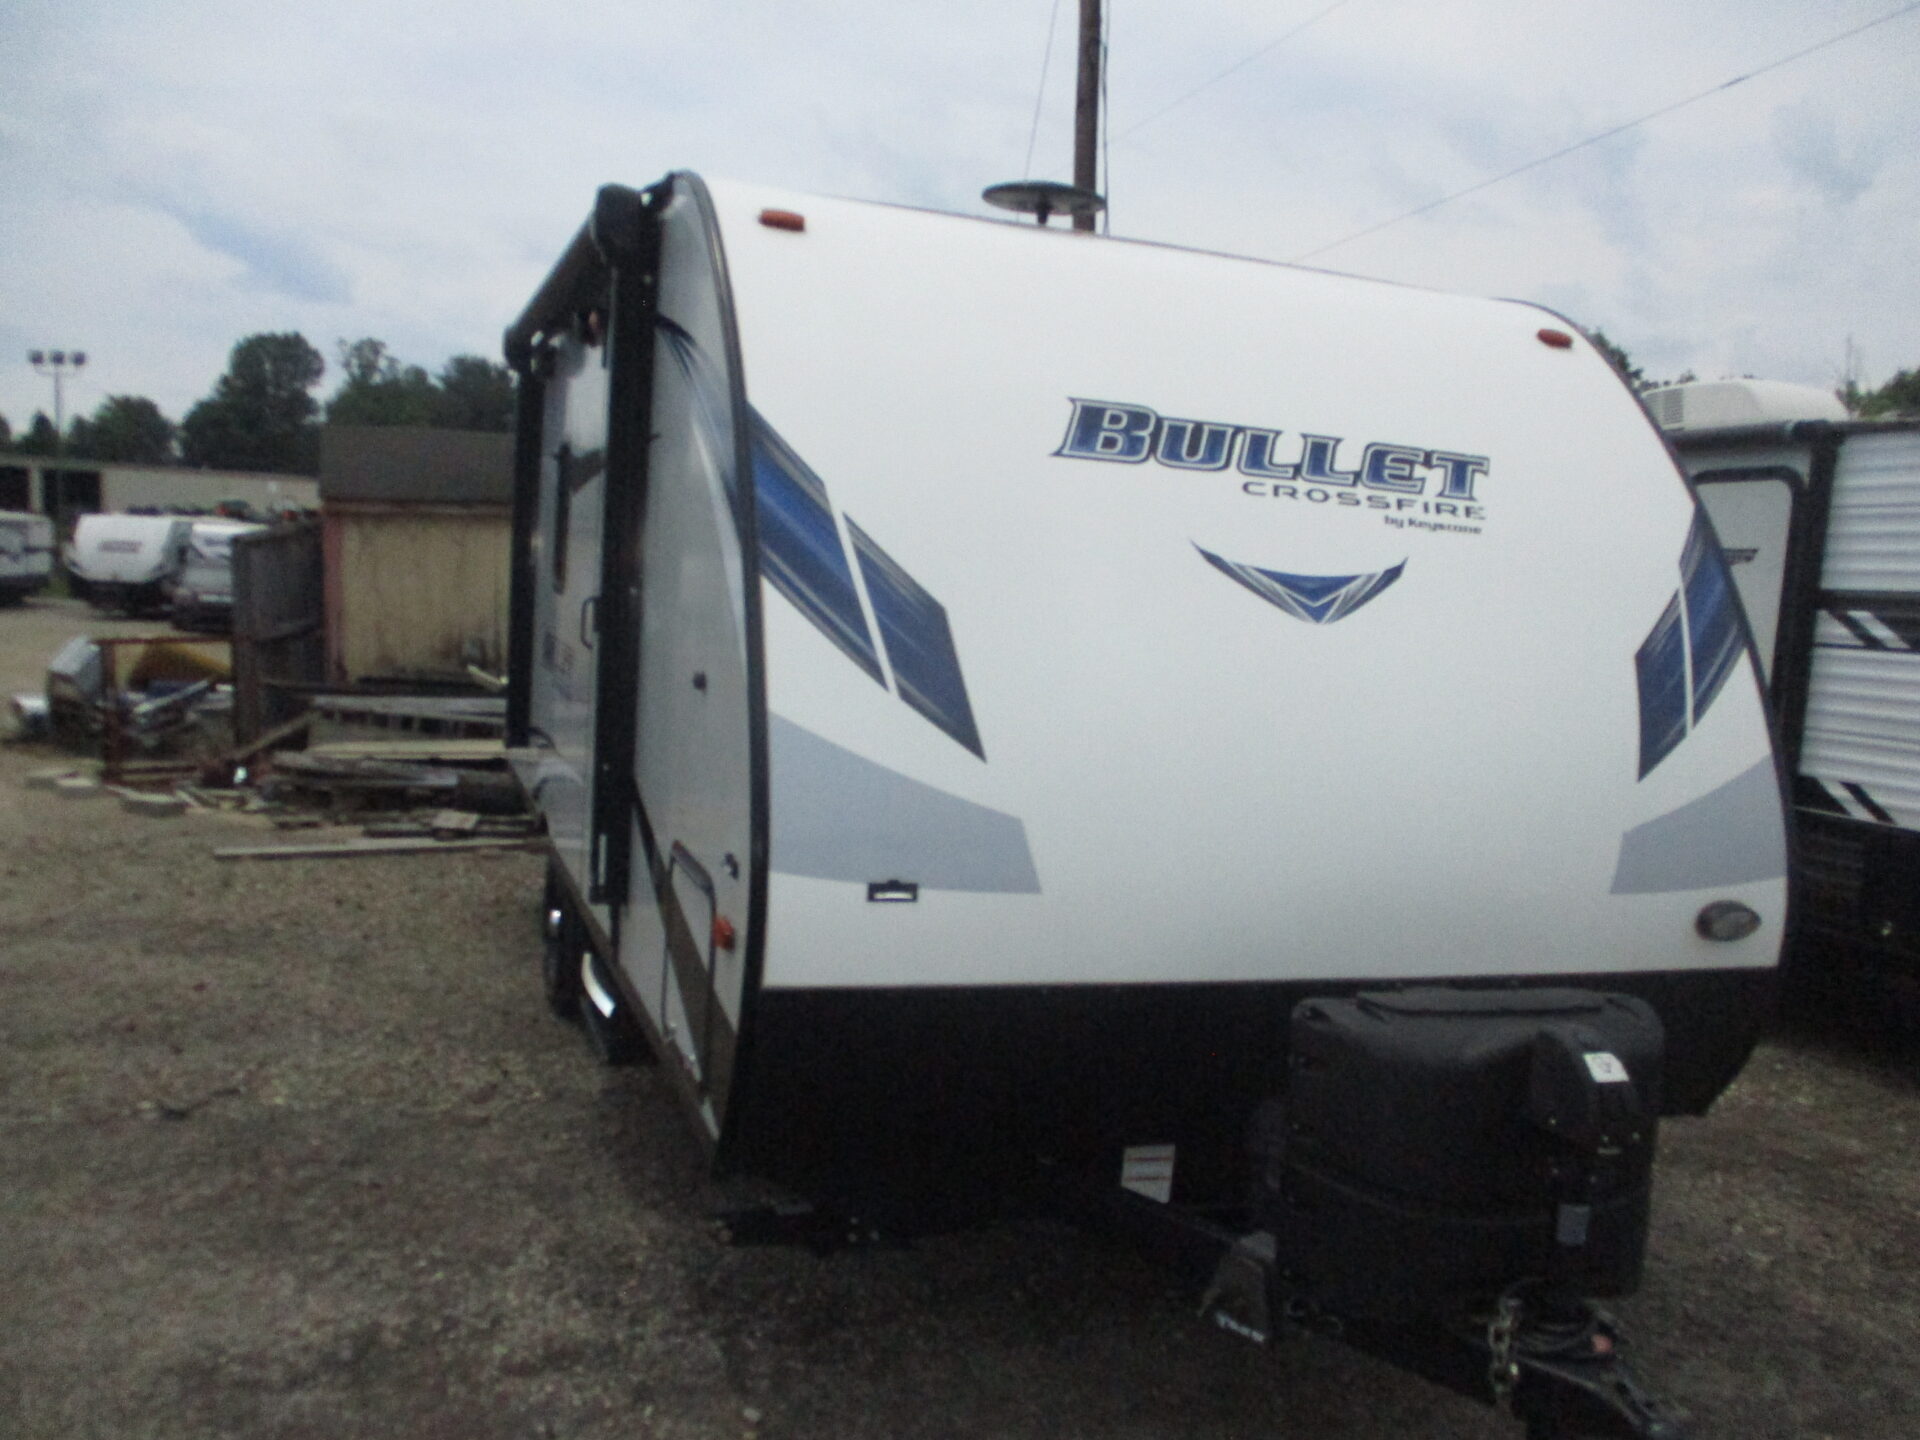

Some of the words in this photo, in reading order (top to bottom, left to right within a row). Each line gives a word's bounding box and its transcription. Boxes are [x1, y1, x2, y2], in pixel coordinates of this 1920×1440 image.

[1050, 397, 1490, 501] BULLET
[1242, 481, 1486, 520] CROSSFIRE
[1384, 514, 1404, 529] by
